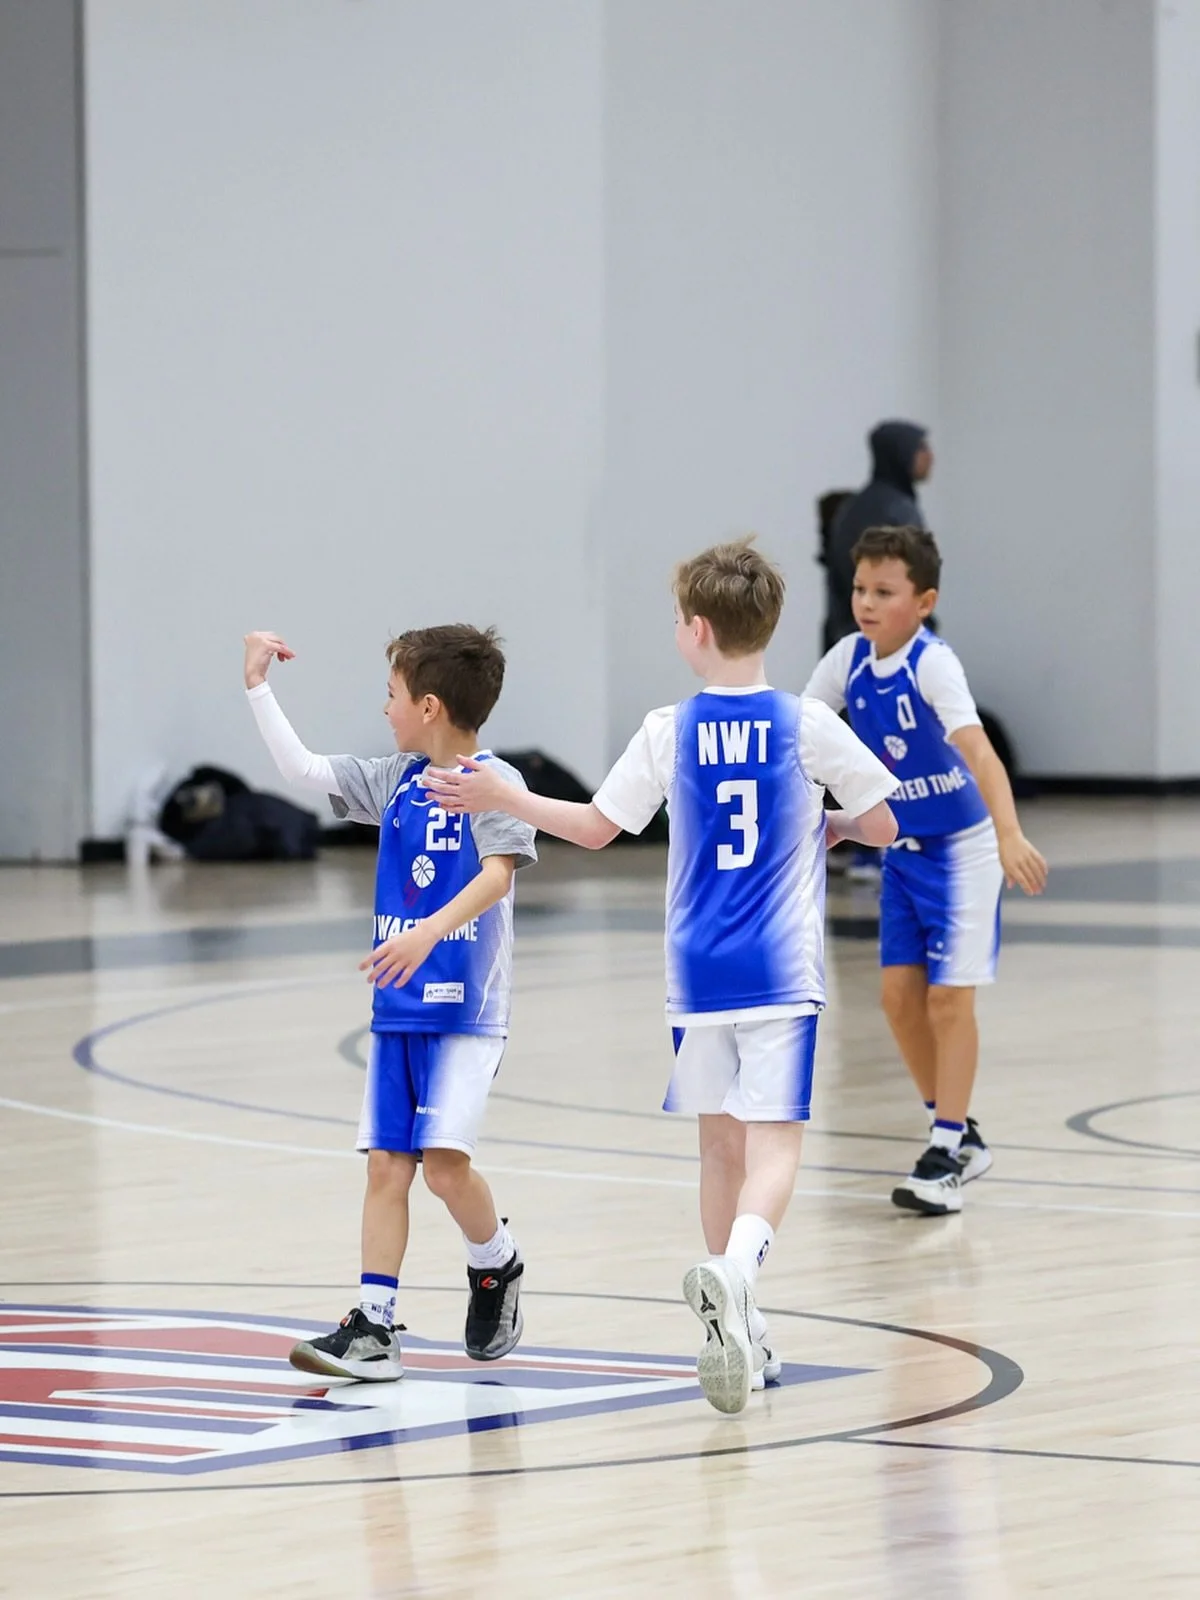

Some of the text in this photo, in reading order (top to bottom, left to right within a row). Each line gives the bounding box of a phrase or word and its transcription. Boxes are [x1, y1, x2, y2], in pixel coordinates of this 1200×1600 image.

[698, 720, 771, 765] NWT
[928, 766, 968, 795] TIME
[425, 807, 463, 851] 23
[716, 779, 759, 870] 3
